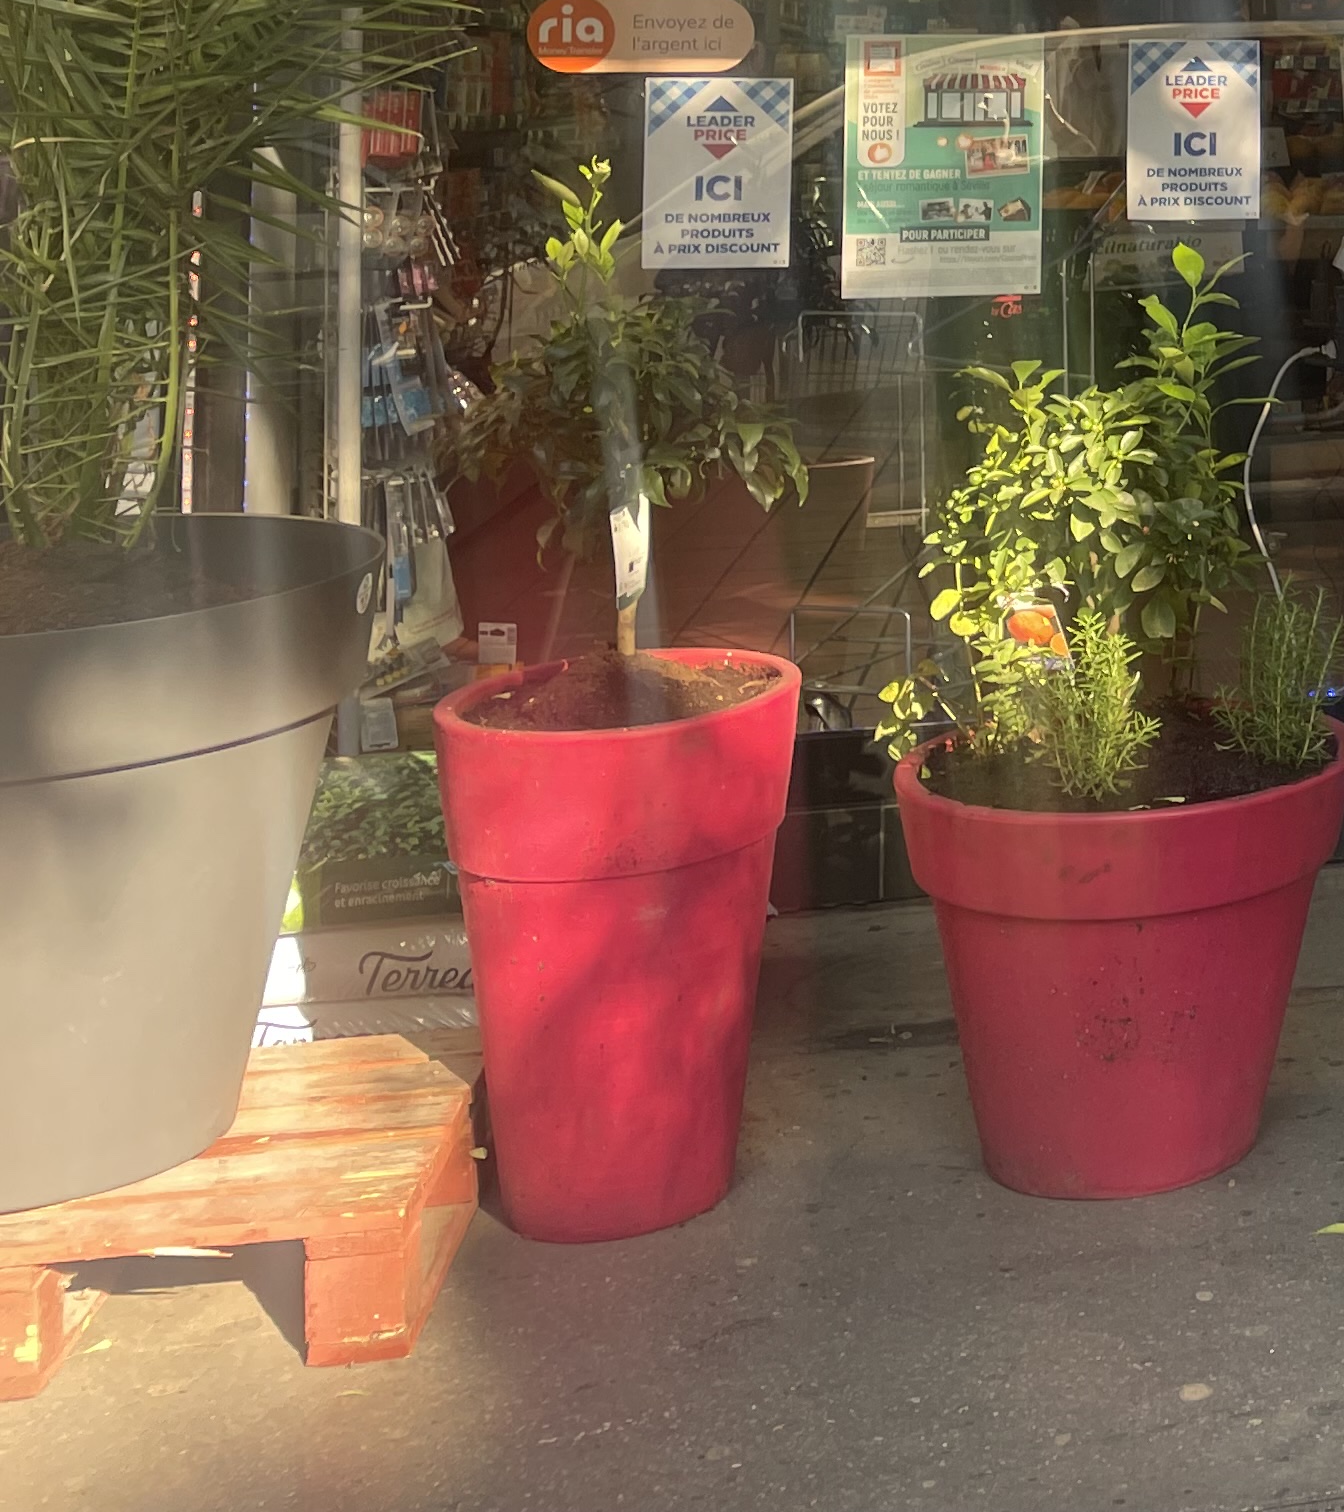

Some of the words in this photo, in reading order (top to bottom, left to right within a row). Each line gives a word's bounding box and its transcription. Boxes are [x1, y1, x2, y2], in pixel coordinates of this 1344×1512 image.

[539, 4, 604, 44] ria
[633, 14, 707, 32] Envoyez
[713, 14, 734, 29] de
[631, 37, 699, 54] l'argent
[704, 37, 721, 51] ici
[1166, 75, 1228, 86] LEADER
[1172, 88, 1220, 99] PRICE
[863, 102, 898, 114] VOTEZ
[687, 115, 755, 128] LEADER
[863, 116, 893, 127] POUR
[694, 129, 747, 142] PRICE
[862, 129, 893, 141] NOUS
[1174, 132, 1217, 156] ICI
[858, 170, 870, 181] ET
[872, 170, 906, 180] TENTEZ
[909, 170, 921, 180] DE
[923, 169, 961, 180] GAGNER
[1147, 168, 1163, 177] DE
[1167, 167, 1242, 177] NOMBREUX
[695, 175, 742, 201] ICI
[896, 181, 950, 193] romantique
[1161, 182, 1228, 192] PRODUITS
[1138, 194, 1147, 207] À
[1150, 197, 1180, 206] PRIX
[1183, 196, 1252, 206] DISCOUNT
[665, 213, 684, 224] DE
[688, 212, 771, 223] NOMBREUX
[681, 228, 754, 239] PRODUITS
[902, 229, 929, 241] POUR
[931, 228, 986, 240] PARTICIPER
[654, 241, 664, 254] À
[669, 243, 701, 254] PRIX
[705, 243, 780, 254] DISCOUNT
[938, 247, 948, 255] ou
[334, 881, 380, 894] Favorise
[382, 874, 441, 890] croissance
[334, 897, 347, 908] et
[348, 892, 425, 906] enracinement
